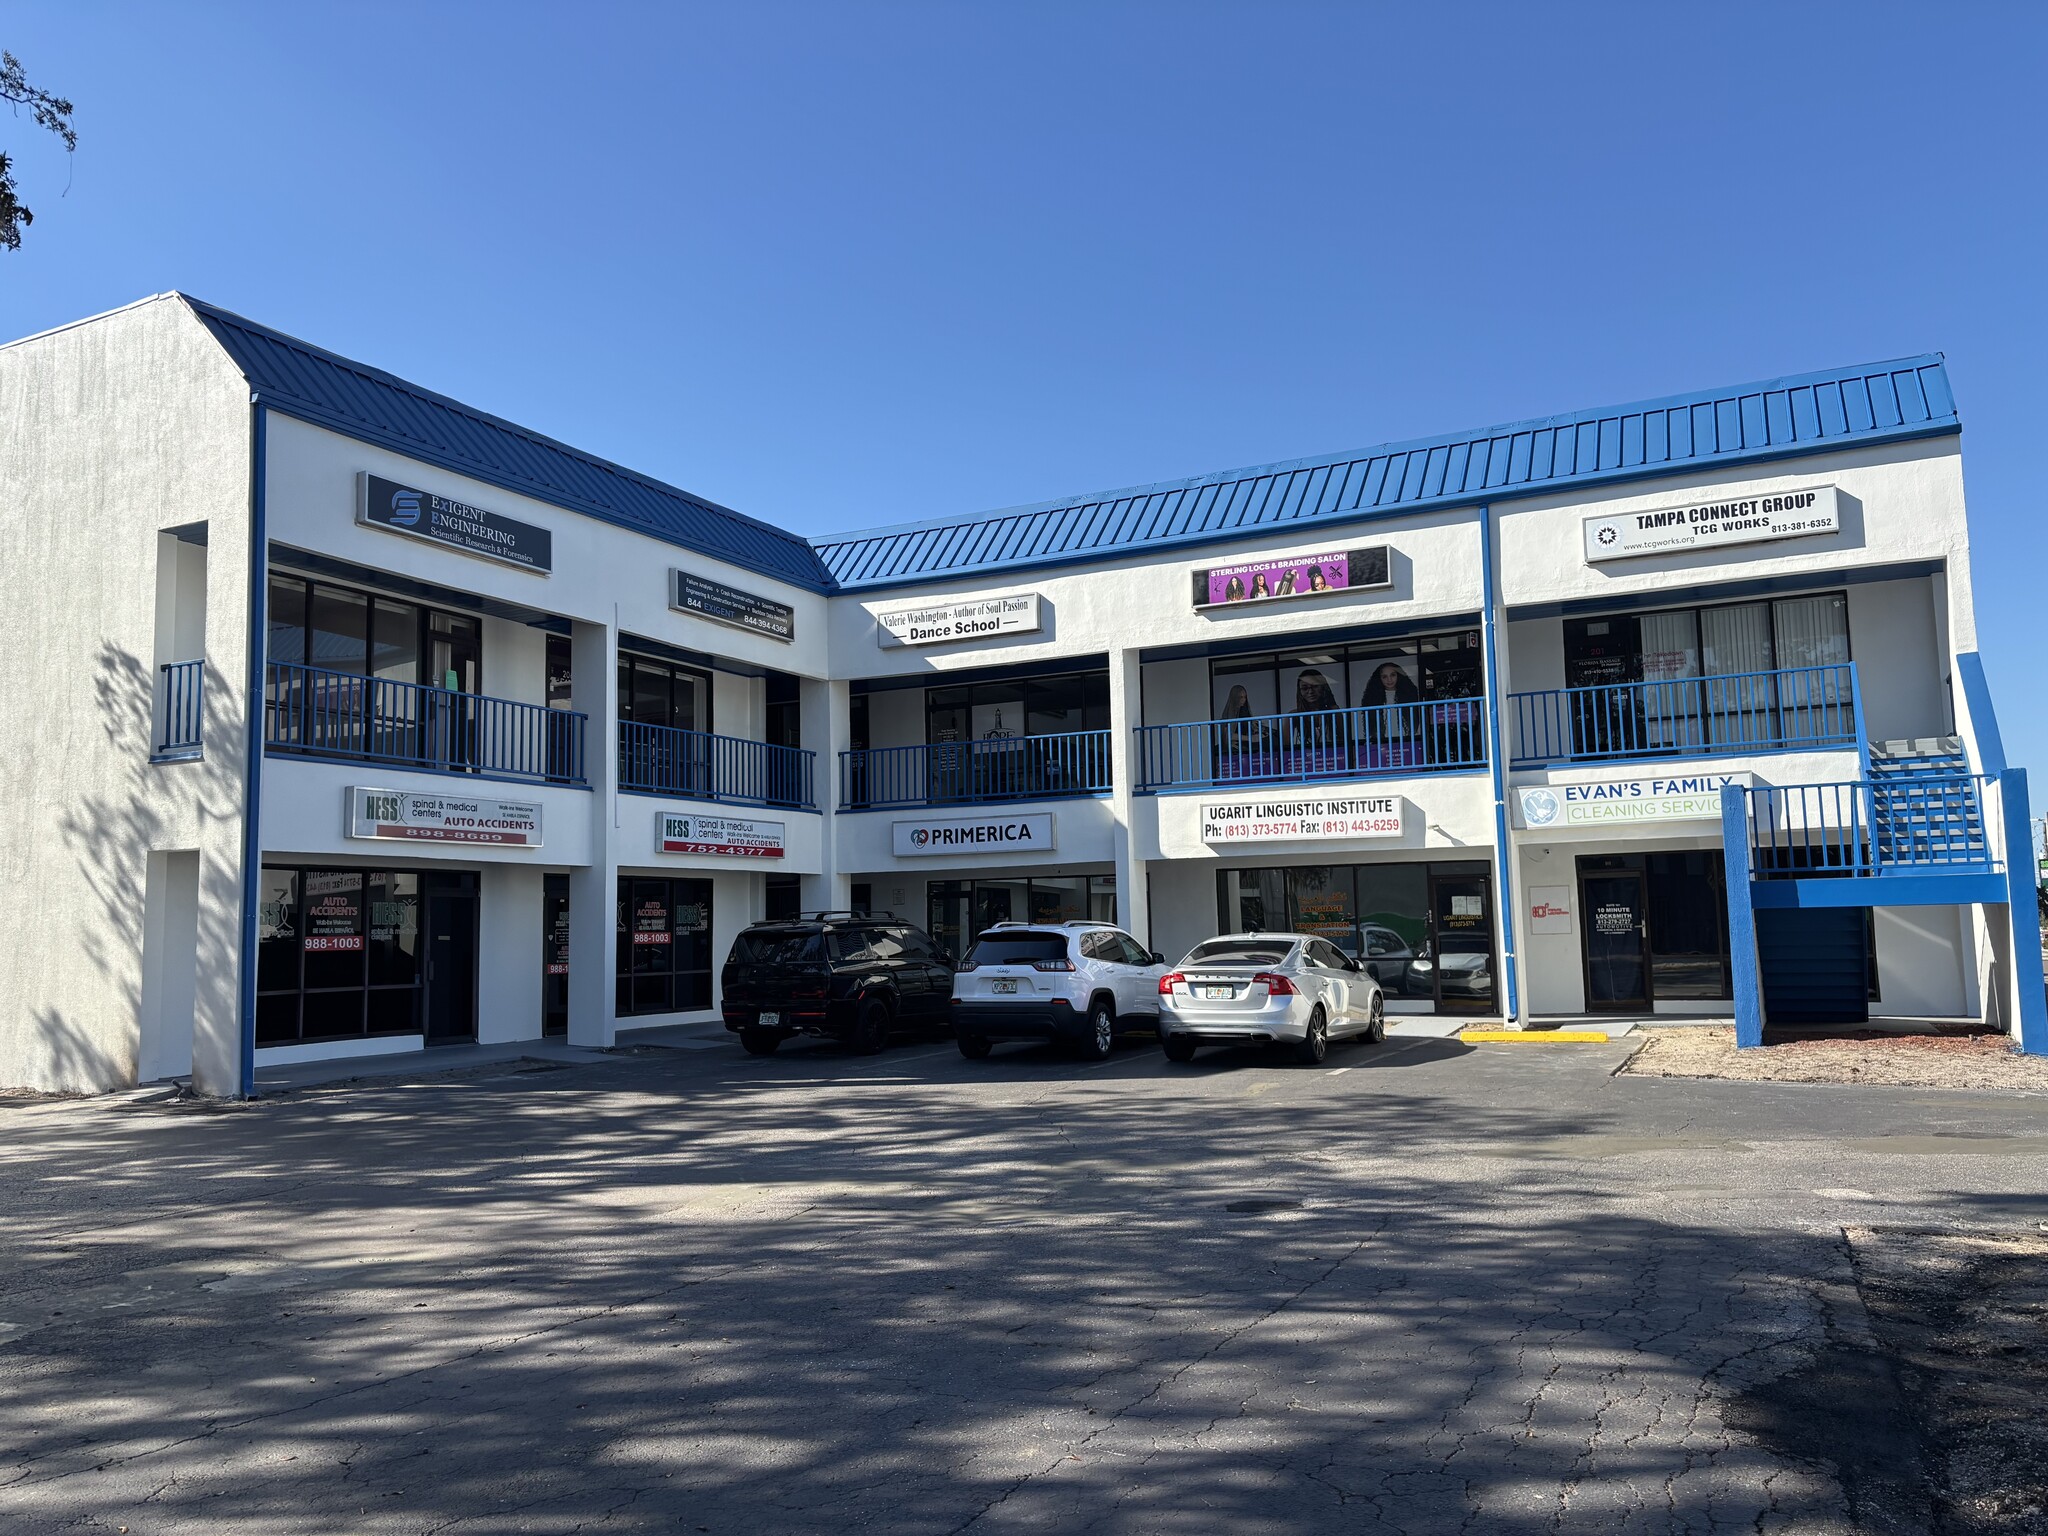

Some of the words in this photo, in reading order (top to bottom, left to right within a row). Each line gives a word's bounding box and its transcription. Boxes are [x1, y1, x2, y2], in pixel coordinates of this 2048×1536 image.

[1636, 510, 1686, 530] TAMPA
[1689, 500, 1758, 523] CONNECT
[1762, 493, 1816, 513] GROUP
[431, 511, 516, 546] ENGINEERING
[1692, 524, 1718, 536] TCG
[1721, 517, 1770, 532] WORKS
[1771, 518, 1832, 534] 813-381-6352
[430, 526, 464, 543] Scientific
[465, 536, 496, 553] Research
[496, 546, 502, 554] &
[503, 547, 534, 563] Forensics
[1623, 535, 1695, 550] www.tcgworks.org
[1210, 566, 1248, 577] STERLING
[1249, 563, 1271, 573] LOCS
[1278, 557, 1317, 569] BRAIDING
[1318, 553, 1346, 563] SALON
[687, 598, 702, 609] 844
[704, 603, 735, 619] EXIGENT
[883, 614, 906, 627] Valerie
[907, 609, 948, 625] Washington
[952, 605, 976, 619] Author
[977, 603, 985, 615] of
[985, 600, 1001, 614] Soul
[1002, 599, 1029, 613] Passion
[910, 626, 951, 640] Dance
[955, 617, 1000, 634] School
[1653, 776, 1734, 795] FAMILY
[366, 795, 398, 822] HESS
[412, 799, 436, 810] spinal
[438, 801, 445, 810] &
[446, 802, 478, 813] medical
[1210, 806, 1253, 820] UGARIT
[1256, 802, 1324, 818] LINGUISTIC
[1327, 800, 1393, 815] INSTITUTE
[1571, 803, 1656, 820] CLEANING
[1662, 799, 1721, 814] SERVIC
[412, 809, 442, 819] centers
[444, 816, 475, 827] AUTO
[477, 818, 535, 831] ACCIDENTS
[665, 819, 690, 838] HESS
[698, 820, 718, 830] spinal
[719, 821, 726, 830] &
[726, 821, 754, 832] medical
[1205, 823, 1222, 837] Ph:
[1225, 823, 1250, 839] (813)
[1252, 822, 1298, 836] 373-5774
[1300, 819, 1320, 833] Fax:
[1322, 820, 1349, 835] (813)
[1351, 818, 1400, 832] 443-6259
[406, 829, 503, 841] 898-8689
[698, 829, 724, 839] centers
[931, 823, 1032, 845] PRIMERICA
[686, 844, 765, 856] 752-4377
[746, 839, 780, 847] ACCIDENTS
[322, 897, 348, 907] AUTO
[645, 901, 660, 909] AUTO
[1300, 905, 1342, 913] LANGUAGE
[309, 907, 358, 916] ACCIDENTS
[372, 901, 405, 925] HESS
[637, 909, 667, 917] ACCIDENTS
[1295, 921, 1350, 929] TRANSLATION
[304, 937, 361, 949] 988-1003
[634, 934, 669, 942] 988-1003
[550, 965, 568, 973] 988-1
